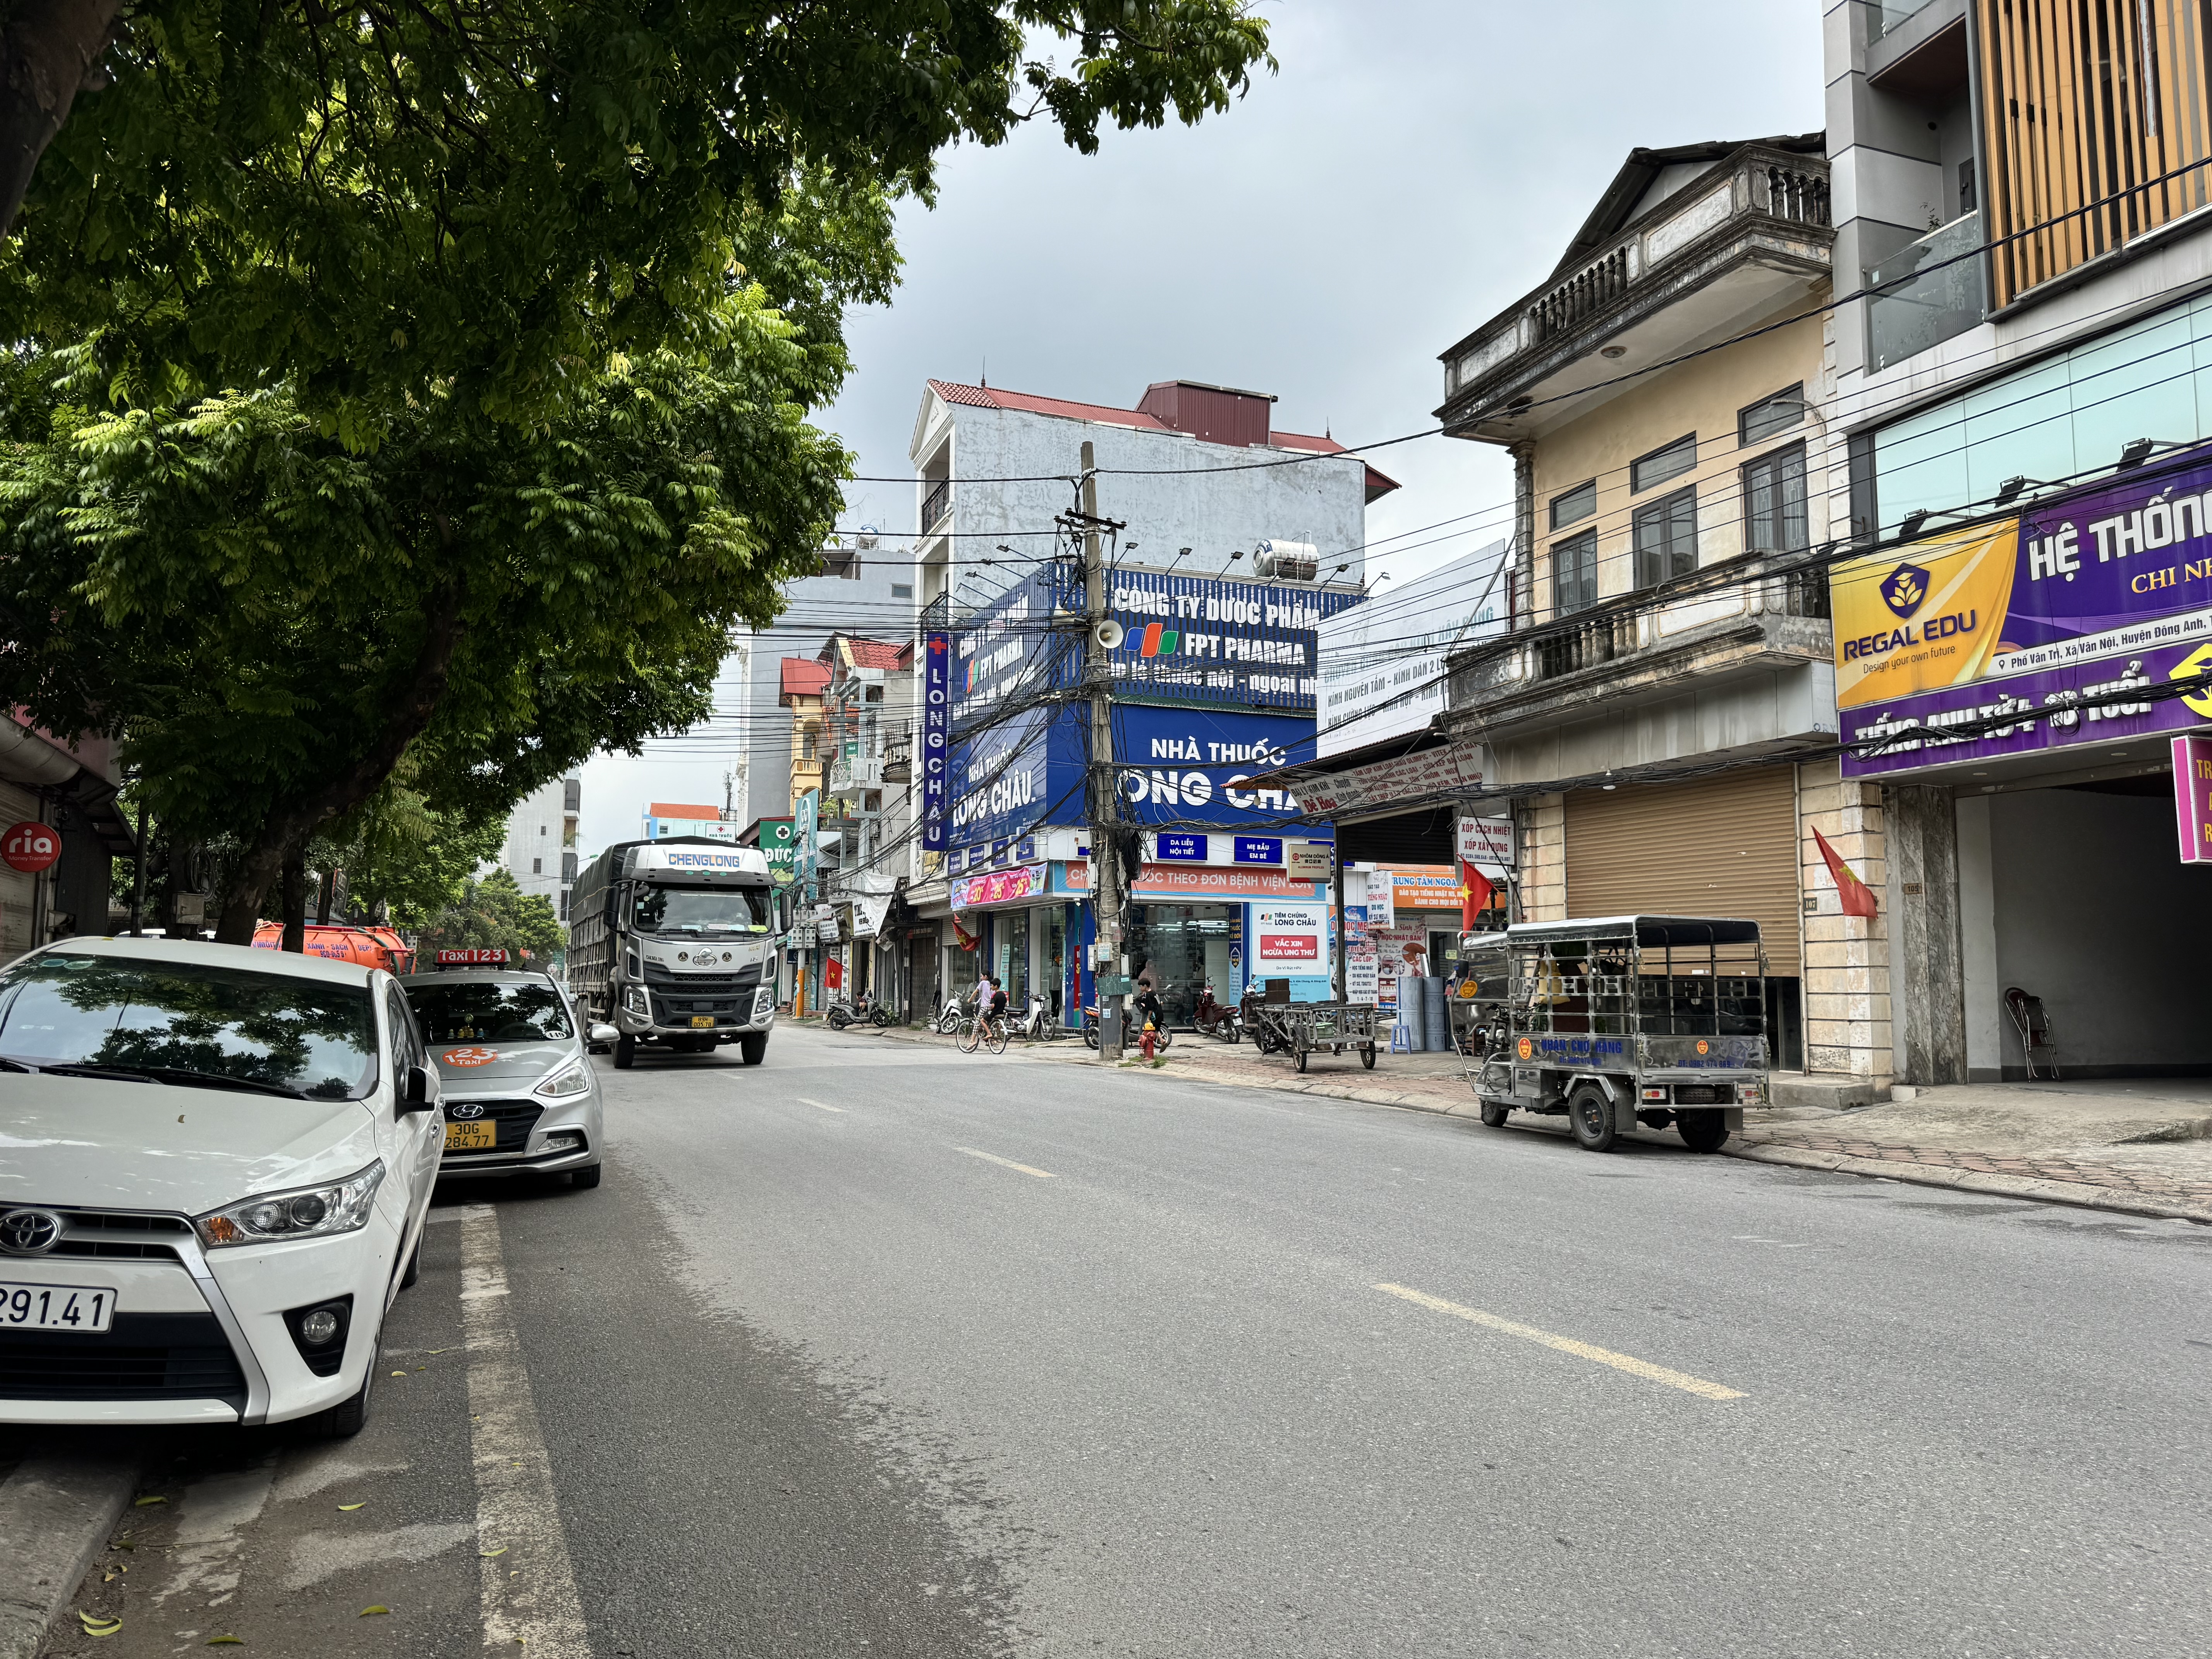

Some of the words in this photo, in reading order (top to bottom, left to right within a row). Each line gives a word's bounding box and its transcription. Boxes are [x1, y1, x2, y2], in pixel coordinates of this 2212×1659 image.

[2029, 522, 2080, 581] HỆ
[2088, 486, 2212, 562] THỐN
[2131, 567, 2176, 593] CHI
[1114, 585, 1170, 617] CÔNG
[1175, 596, 1200, 620] TY
[1206, 597, 1260, 627] DƯỢC
[1267, 600, 1319, 631] PHẨM
[1843, 628, 1919, 661] REGAL
[1924, 609, 1977, 641] EDU
[2011, 653, 2028, 668] Phố
[2030, 650, 2049, 665] Vân
[2051, 647, 2063, 663] Trì,
[2065, 644, 2076, 659] Xã
[2079, 640, 2098, 656] Vân
[2100, 635, 2119, 652] Nội,
[2121, 629, 2152, 648] Huyện
[2154, 623, 2180, 641] Đông
[2183, 618, 2207, 635] Anh,
[1185, 632, 1220, 658] FPT
[1224, 637, 1305, 666] PHARMA
[1863, 657, 1889, 674] Design
[1891, 656, 1910, 670] your
[1911, 653, 1929, 664] own
[1930, 646, 1955, 661] future
[1300, 678, 1317, 696] nh
[1328, 691, 1342, 707] KÍNH
[1344, 681, 1369, 702] NGUYÊN
[1371, 675, 1385, 693] TẤM
[1394, 668, 1410, 686] KÍNH
[1413, 661, 1428, 679] DÁN
[1430, 660, 1434, 673] 2
[928, 668, 944, 748] LONG
[1855, 711, 1921, 757] TIẾNG
[1152, 735, 1201, 761] NHÀ
[1208, 737, 1286, 766] THUỐC
[968, 756, 984, 783] NHÀ
[928, 757, 943, 842] CHÂU
[953, 787, 988, 828] LONG
[991, 769, 1032, 815] CHÂU
[1115, 769, 1212, 806] ONG
[1225, 774, 1302, 811] CH
[1317, 796, 1338, 811] Hoa
[1462, 820, 1474, 833] XỐP
[1475, 823, 1491, 834] CÁCH
[1493, 825, 1510, 837] NHIỆT
[9, 828, 52, 853] ria
[1170, 848, 1180, 856] NỘI
[1182, 847, 1195, 855] TIẾT
[1182, 837, 1194, 847] LIỄU
[1247, 844, 1255, 852] MẸ
[1464, 838, 1476, 850] XỐP
[1478, 840, 1489, 851] XÂY
[1491, 842, 1508, 854] DỰNG
[668, 854, 740, 868] CHENGLONG
[764, 845, 792, 863] ĐỨC
[1167, 873, 1197, 884] THEO
[1201, 872, 1226, 886] ĐƠN
[1230, 872, 1258, 889] BỆNH
[1262, 874, 1286, 891] VIỆN
[1417, 874, 1433, 885] TÂM
[1435, 877, 1457, 888] NGOẠ
[1274, 938, 1290, 947] VẮC
[439, 949, 468, 961] Taxi
[473, 949, 503, 962] 123
[446, 1047, 499, 1063] 123
[455, 1124, 479, 1135] 30G
[445, 1135, 489, 1148] 284.77
